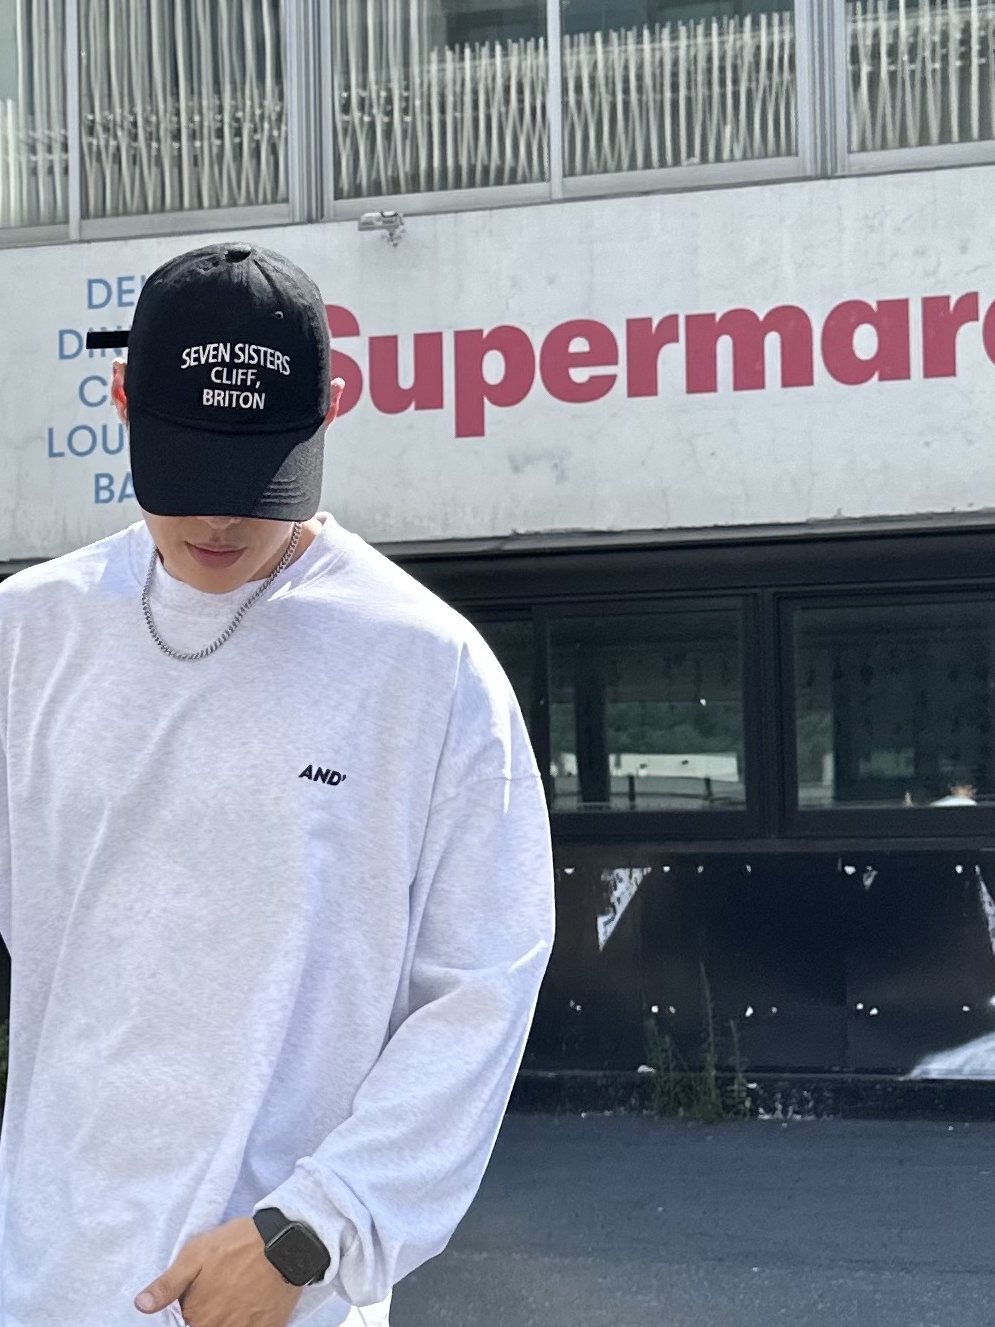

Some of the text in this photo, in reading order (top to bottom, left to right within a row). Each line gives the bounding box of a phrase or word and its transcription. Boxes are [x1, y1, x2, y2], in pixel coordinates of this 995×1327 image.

[87, 275, 146, 309] DE
[180, 342, 291, 376] SEVEN SISTERS
[327, 290, 995, 438] upermar
[210, 366, 261, 389] CLIFF,
[202, 388, 265, 410] BRITON
[48, 423, 124, 458] LOU
[94, 471, 136, 504] BA
